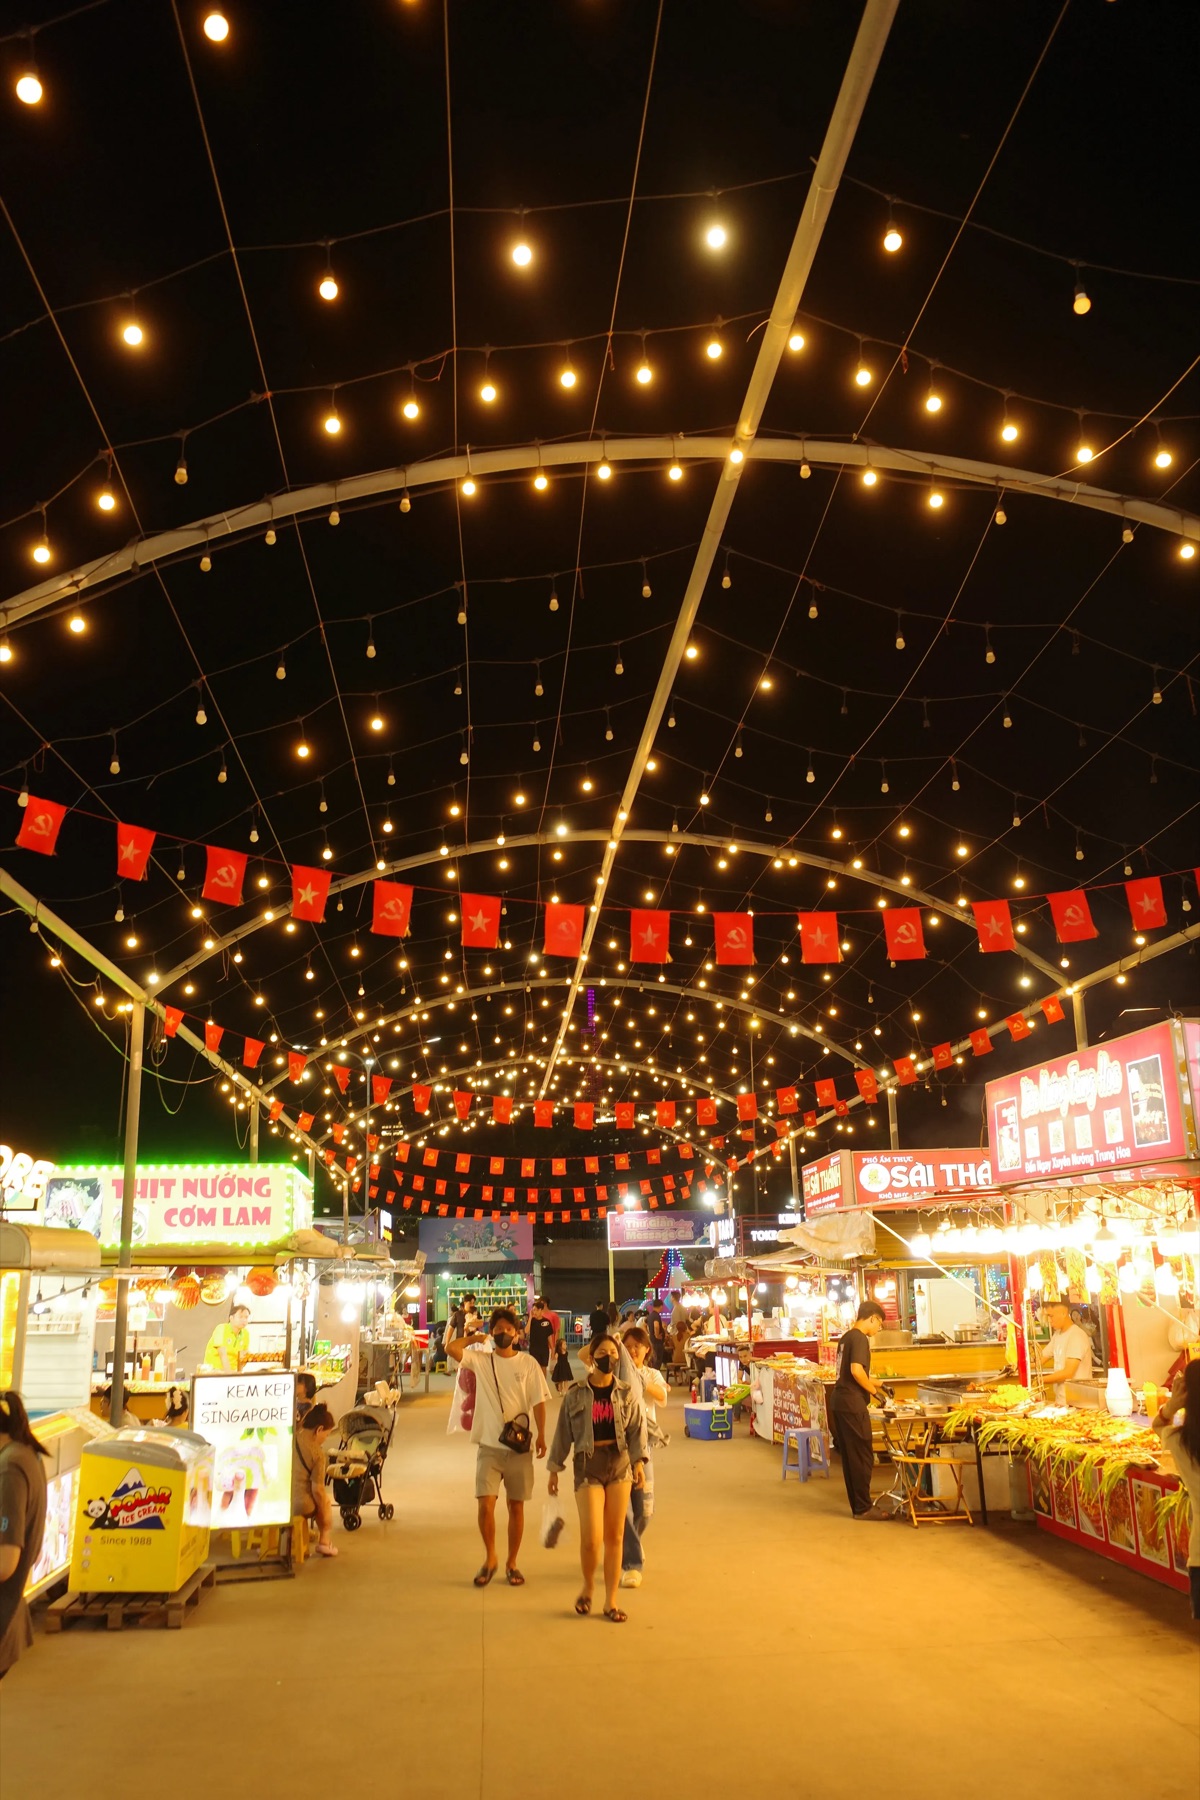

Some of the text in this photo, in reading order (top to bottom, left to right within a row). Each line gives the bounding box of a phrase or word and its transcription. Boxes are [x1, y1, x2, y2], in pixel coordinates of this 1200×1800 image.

[1094, 1149, 1115, 1163] Trung
[1116, 1145, 1131, 1159] Hoa
[183, 1172, 272, 1198] NƯỚNG
[890, 1162, 936, 1188] SÀI
[164, 1205, 272, 1227] CƠM LAM
[227, 1385, 259, 1398] KEM
[201, 1407, 289, 1424] SINGAPORE
[108, 1486, 172, 1518] POLAR
[121, 1505, 166, 1525] ICE CREAM
[100, 1536, 152, 1546] Since 1988
